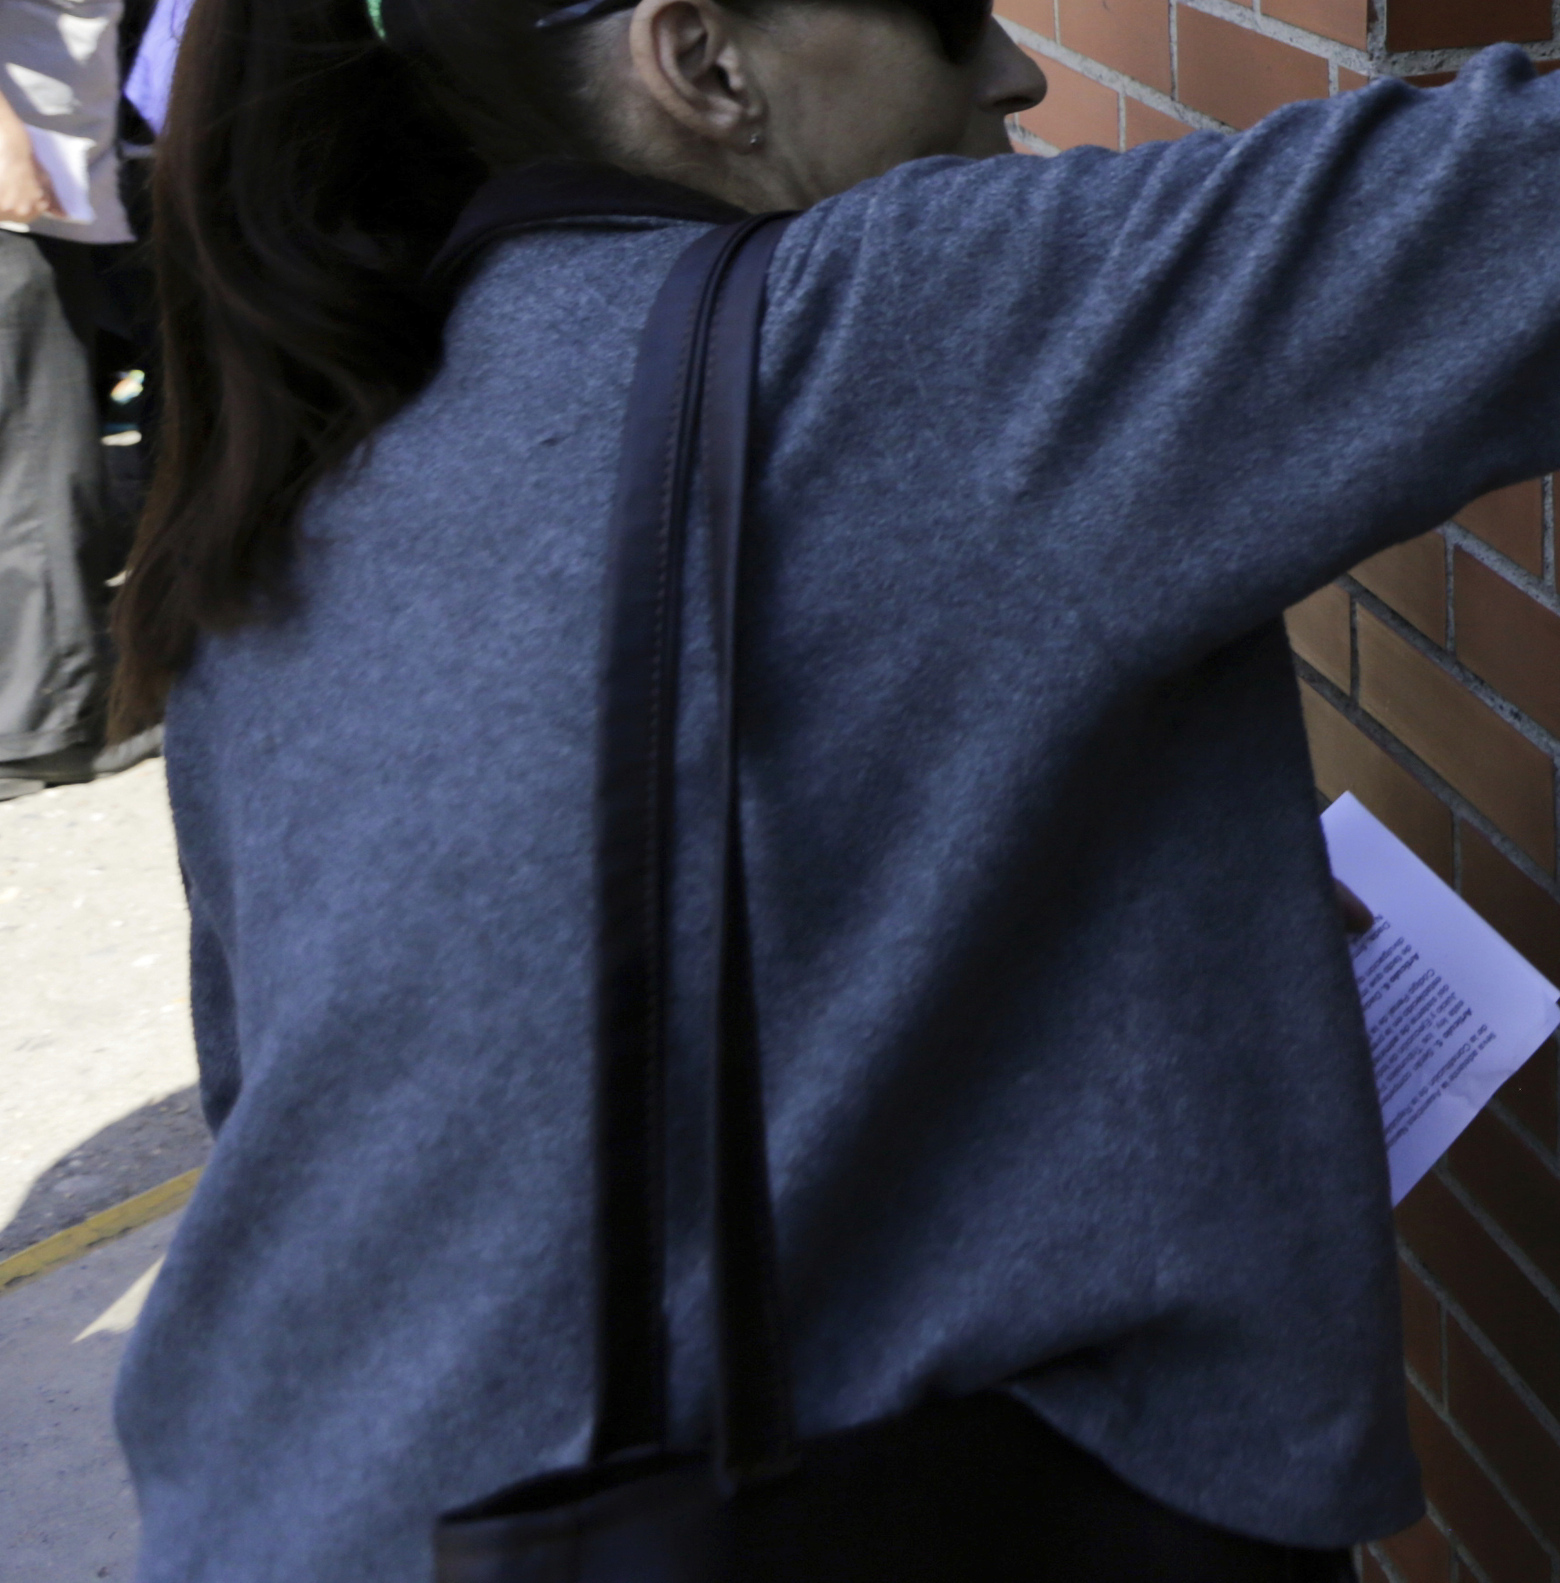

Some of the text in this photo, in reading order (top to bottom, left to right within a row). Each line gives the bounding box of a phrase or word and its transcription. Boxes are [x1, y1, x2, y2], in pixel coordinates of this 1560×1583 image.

[1364, 936, 1404, 976] divulgación
[1400, 943, 1412, 955] de
[1382, 954, 1402, 973] facto
[1368, 971, 1383, 988] que
[1407, 968, 1435, 994] Código
[1401, 975, 1442, 1017] establecido
[1436, 983, 1449, 998] del
[1387, 993, 1410, 1017] Penal
[1409, 995, 1437, 1025] sistema
[1435, 991, 1456, 1014] Juicio
[1377, 1013, 1389, 1026] de
[1391, 1014, 1404, 1028] en
[1383, 1026, 1394, 1036] la
[1397, 1017, 1432, 1054] Ejecución
[1398, 1023, 1411, 1036] de
[1420, 1031, 1434, 1044] los
[1468, 1033, 1479, 1043] la
[1476, 1023, 1488, 1036] de
[1386, 1045, 1423, 1082] Tribunales
[1387, 1052, 1399, 1064] de
[1428, 1042, 1471, 1086] Constitución
[1448, 1049, 1478, 1081] adelante
[1416, 1085, 1429, 1097] de
[1406, 1088, 1441, 1125] Asamblea
[1409, 1095, 1420, 1105] la
